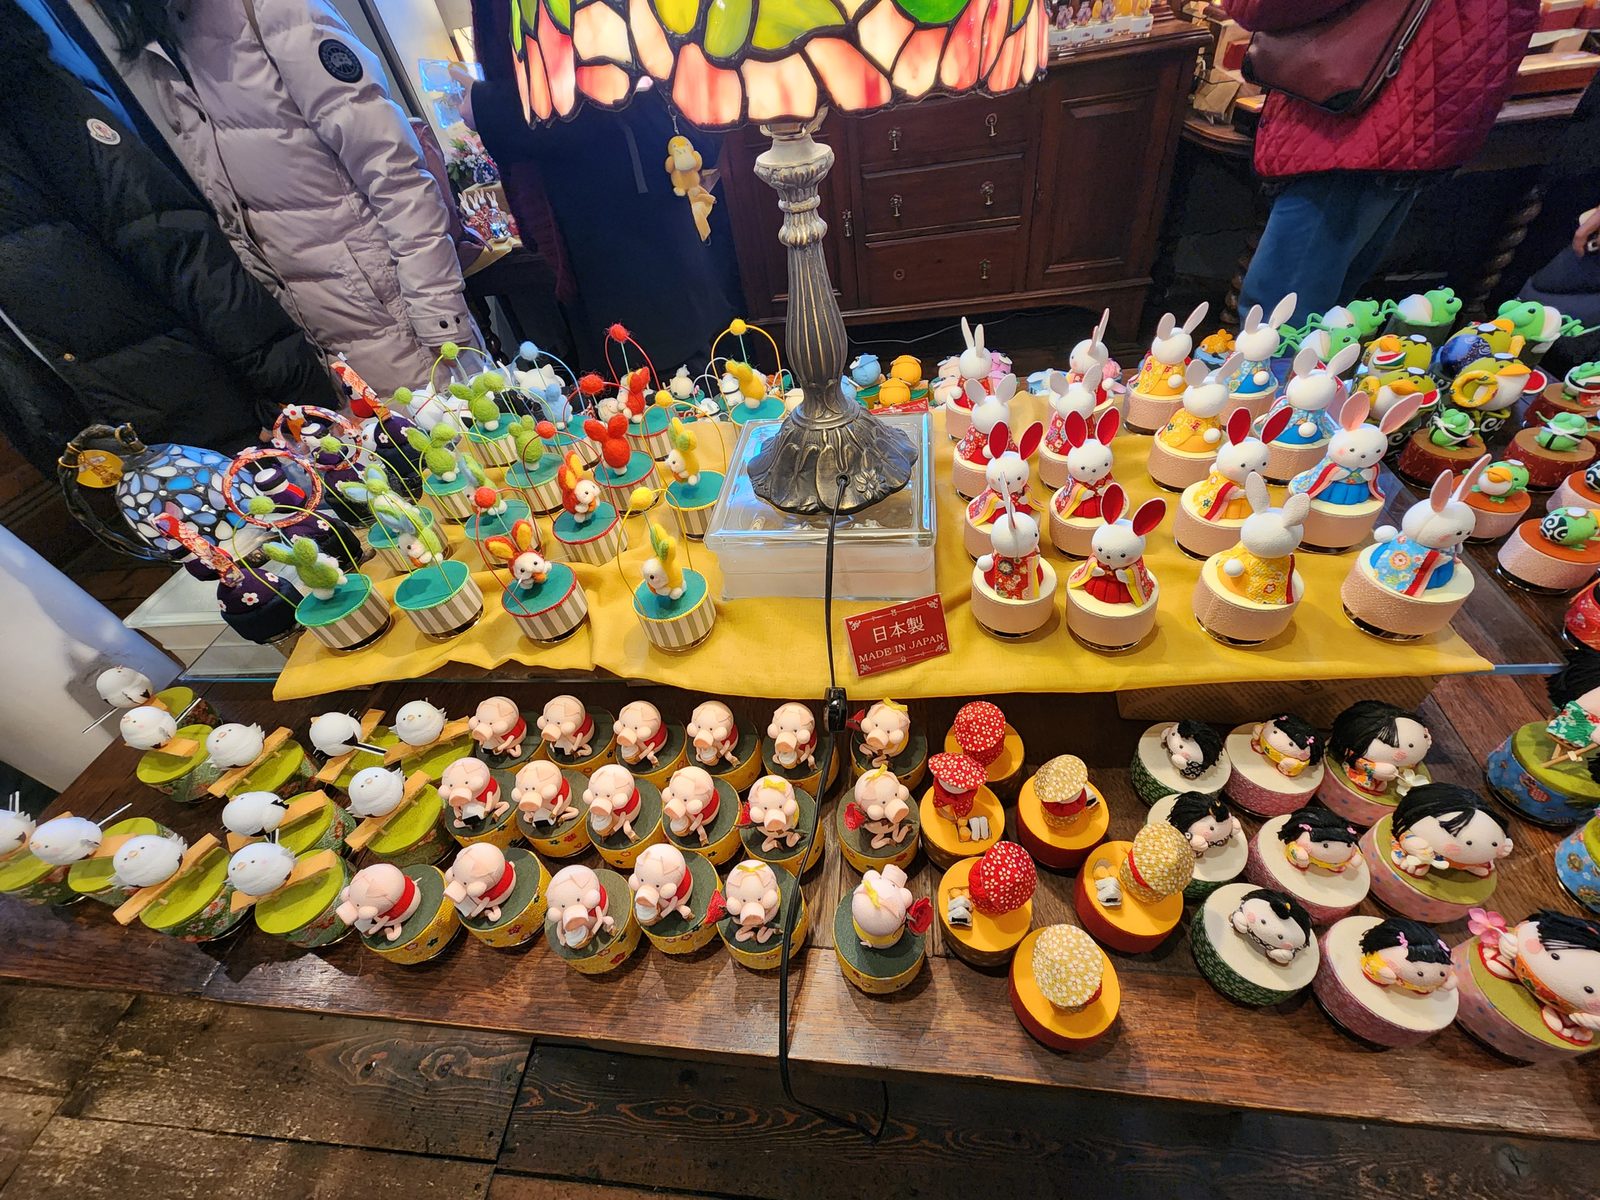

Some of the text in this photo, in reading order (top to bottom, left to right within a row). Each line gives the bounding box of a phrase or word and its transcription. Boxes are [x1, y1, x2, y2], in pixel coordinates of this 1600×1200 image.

[873, 615, 925, 643] 日本製
[858, 633, 944, 663] MADE IN JAPAN
